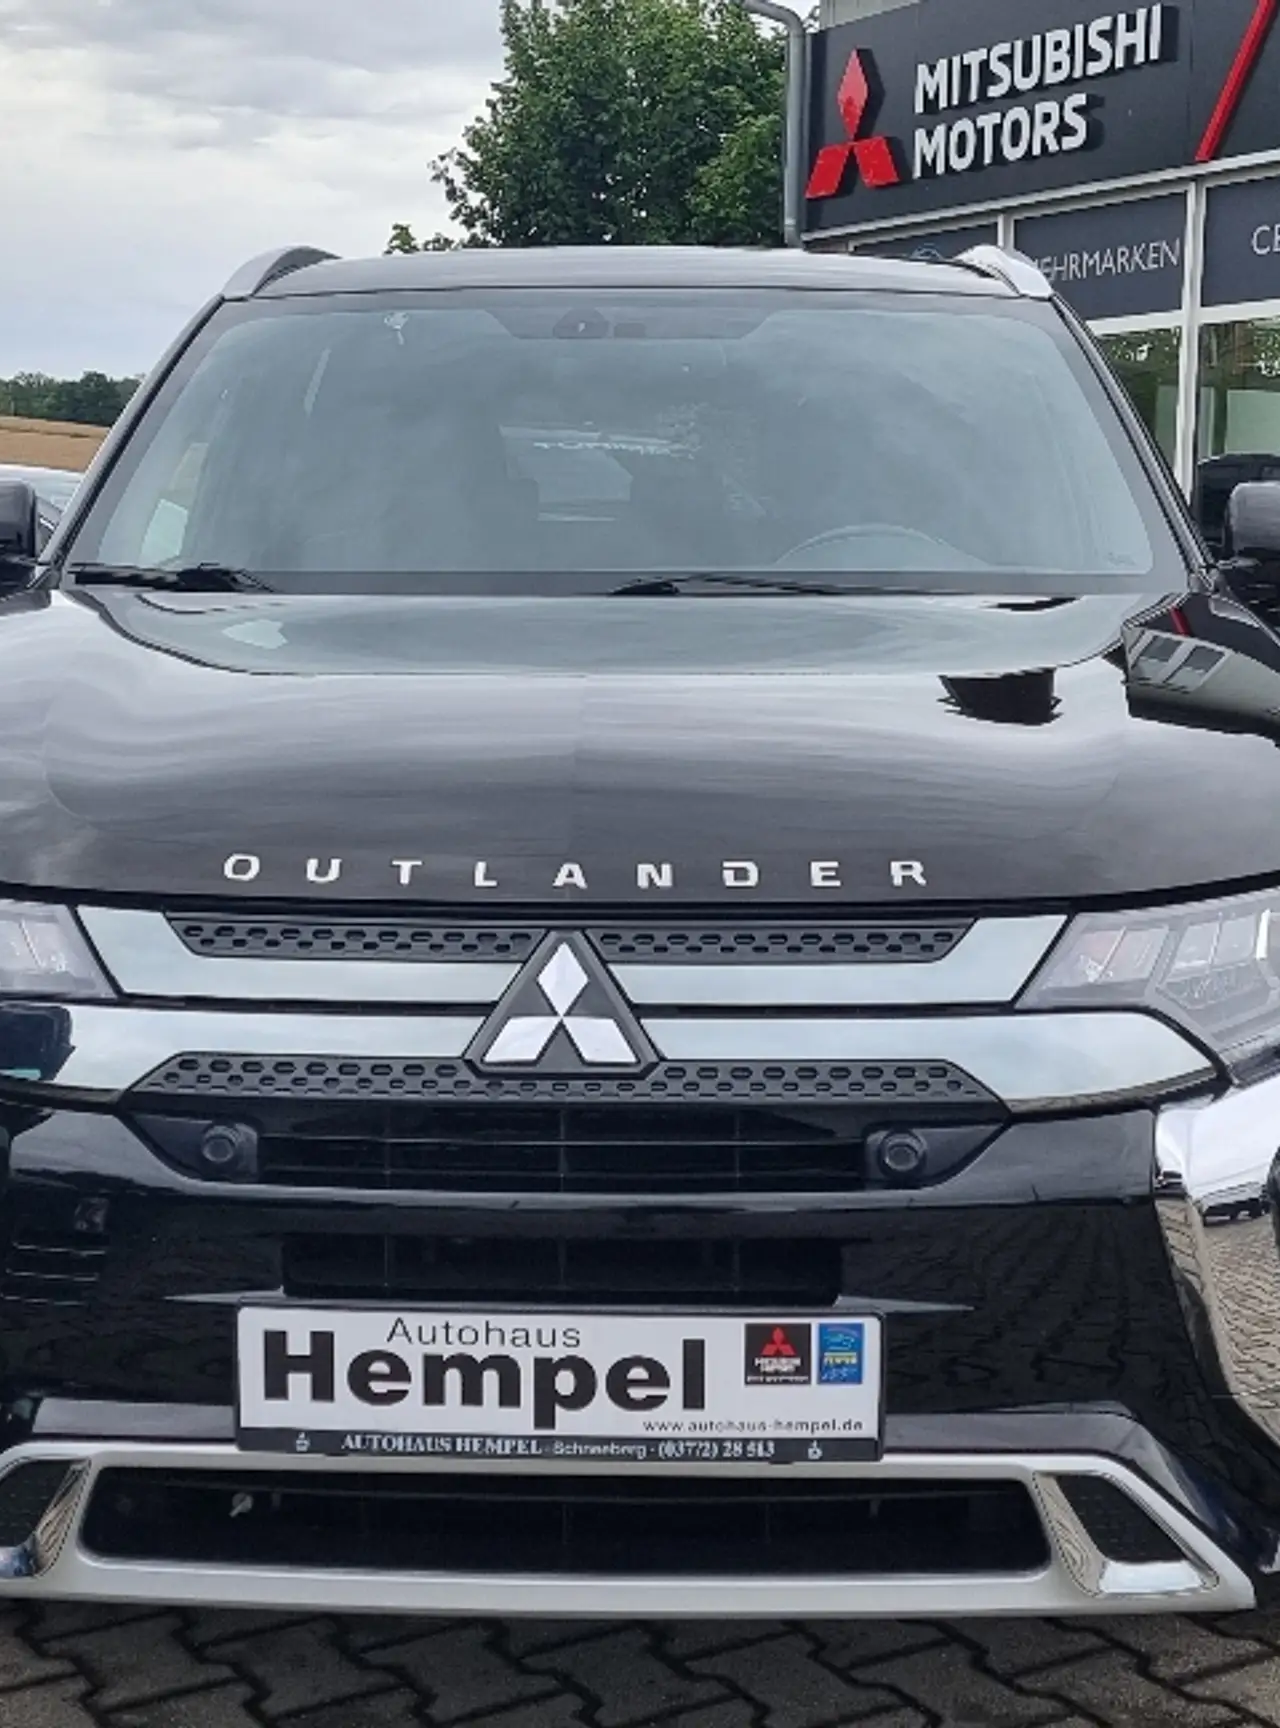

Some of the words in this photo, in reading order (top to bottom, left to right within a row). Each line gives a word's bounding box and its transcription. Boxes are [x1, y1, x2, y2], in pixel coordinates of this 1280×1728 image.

[915, 2, 1162, 114] MITSUBISHI
[913, 93, 1086, 180] MOTORS
[222, 853, 928, 889] OUTLANDER
[386, 1316, 581, 1350] Autohaus
[262, 1328, 706, 1431] Hempel
[340, 1433, 454, 1452] AUTOHAUS
[454, 1437, 543, 1455] HEMPEL
